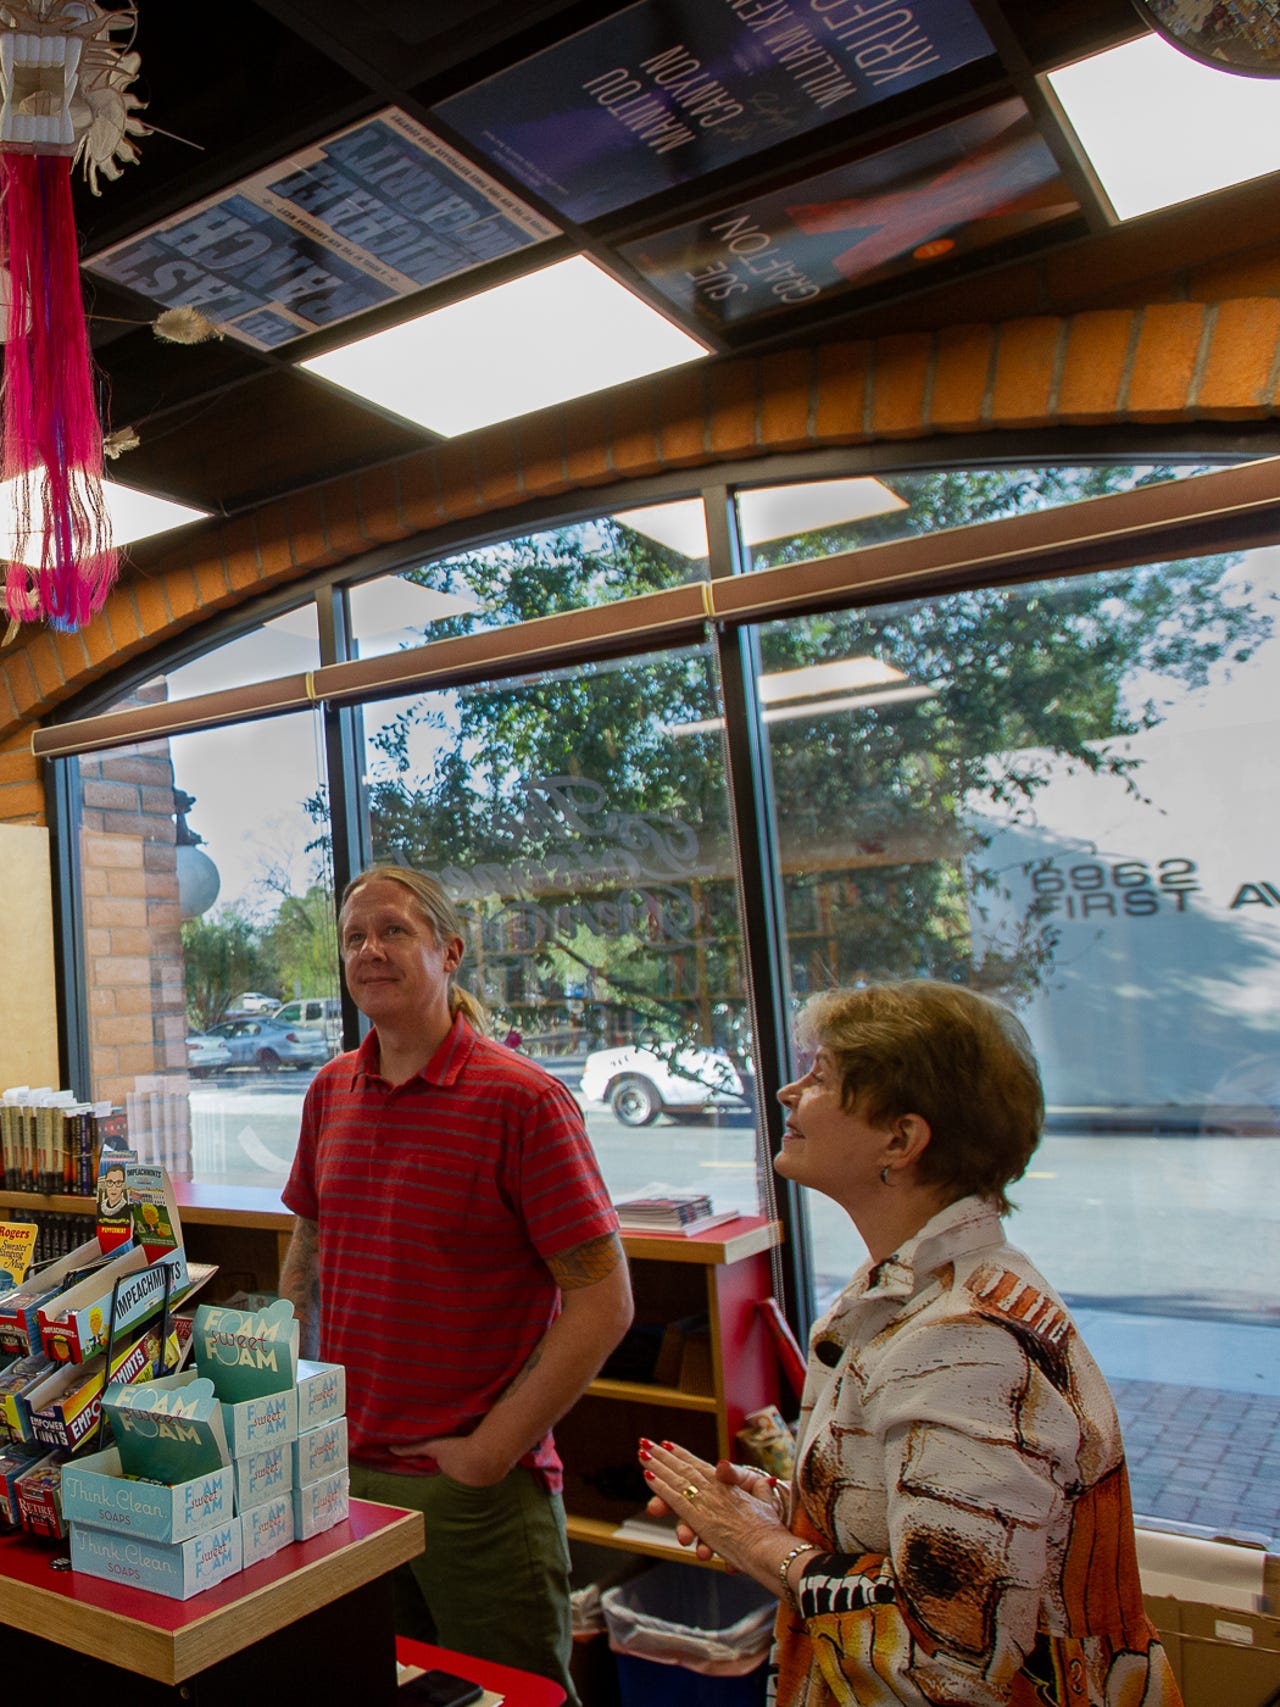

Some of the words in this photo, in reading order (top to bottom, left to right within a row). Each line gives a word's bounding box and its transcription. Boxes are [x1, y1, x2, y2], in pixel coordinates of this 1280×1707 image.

[762, 23, 857, 109] WILLIAM
[639, 43, 744, 128] CANYON
[581, 65, 696, 154] MANITOU
[265, 162, 469, 284] MICHAEL
[160, 205, 360, 322] RANCH
[710, 212, 822, 304] GRAFTON
[684, 259, 749, 302] SUE
[1031, 858, 1202, 894] 6962
[1027, 886, 1202, 919] FIRST
[1, 1239, 28, 1252] Sweater
[3, 1258, 26, 1271] Mug
[203, 1310, 280, 1343] FOAM
[211, 1330, 268, 1353] sweet
[205, 1336, 278, 1373] FOAM
[115, 1387, 199, 1419] FOAM
[246, 1399, 287, 1421] FOAM
[30, 1416, 65, 1432] EMPOWER
[247, 1417, 287, 1441] FOAM
[254, 1410, 281, 1427] sweet
[184, 1475, 223, 1504] FOAM
[191, 1488, 218, 1510] sweet
[99, 1509, 131, 1526] SOAPS
[185, 1498, 223, 1525] FOAM
[195, 1527, 232, 1559] FOAM
[201, 1542, 227, 1564] sweet
[106, 1562, 141, 1580] SOAPS
[195, 1549, 233, 1579] FOAM
